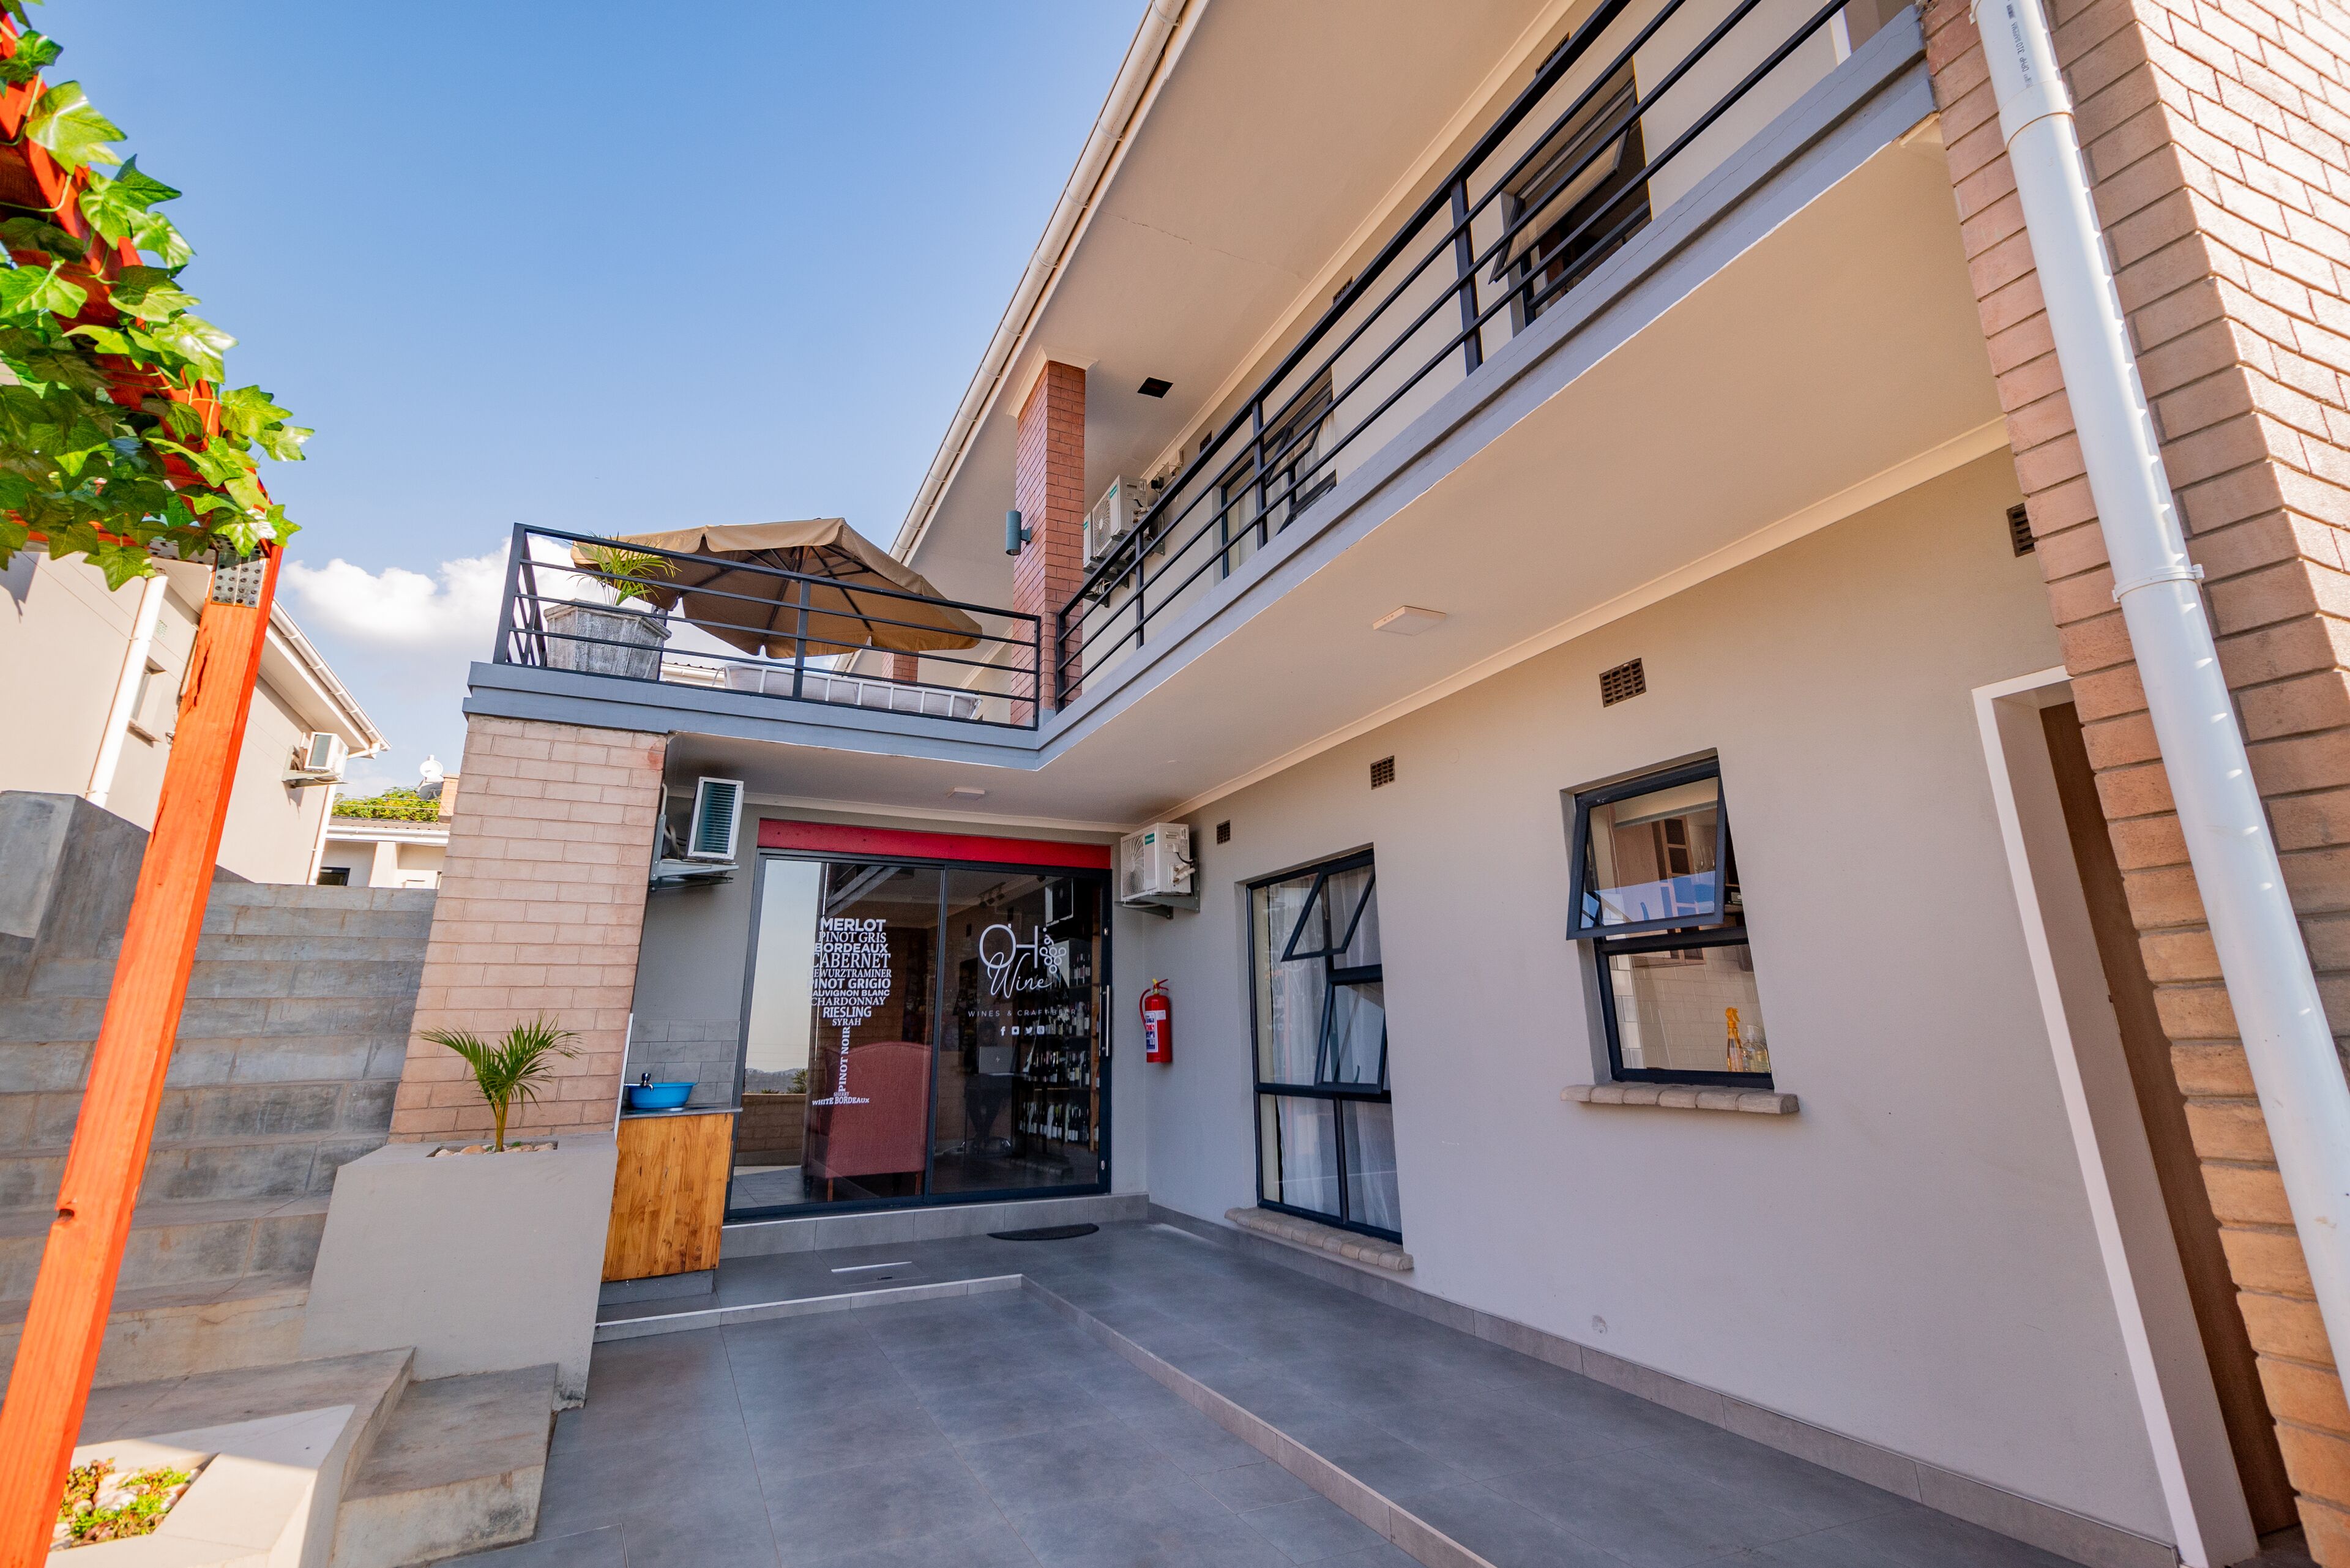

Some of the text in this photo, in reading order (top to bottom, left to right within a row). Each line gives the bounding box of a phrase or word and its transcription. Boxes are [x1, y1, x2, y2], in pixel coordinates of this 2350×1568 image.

[819, 917, 887, 932] MERLOT
[818, 931, 887, 943] PINOT GRIS
[814, 943, 889, 954] BORDEAUX
[811, 952, 891, 968] CABERNET
[987, 952, 1053, 998] Wine
[848, 978, 891, 990] GRIGIO
[811, 996, 887, 1006] CHARDONNAY
[822, 1006, 872, 1018] RIESLING
[832, 1018, 862, 1026] SYRAH
[838, 1026, 851, 1092] PINOT NOIR
[811, 1096, 870, 1106] WHITE BORDEAUX
